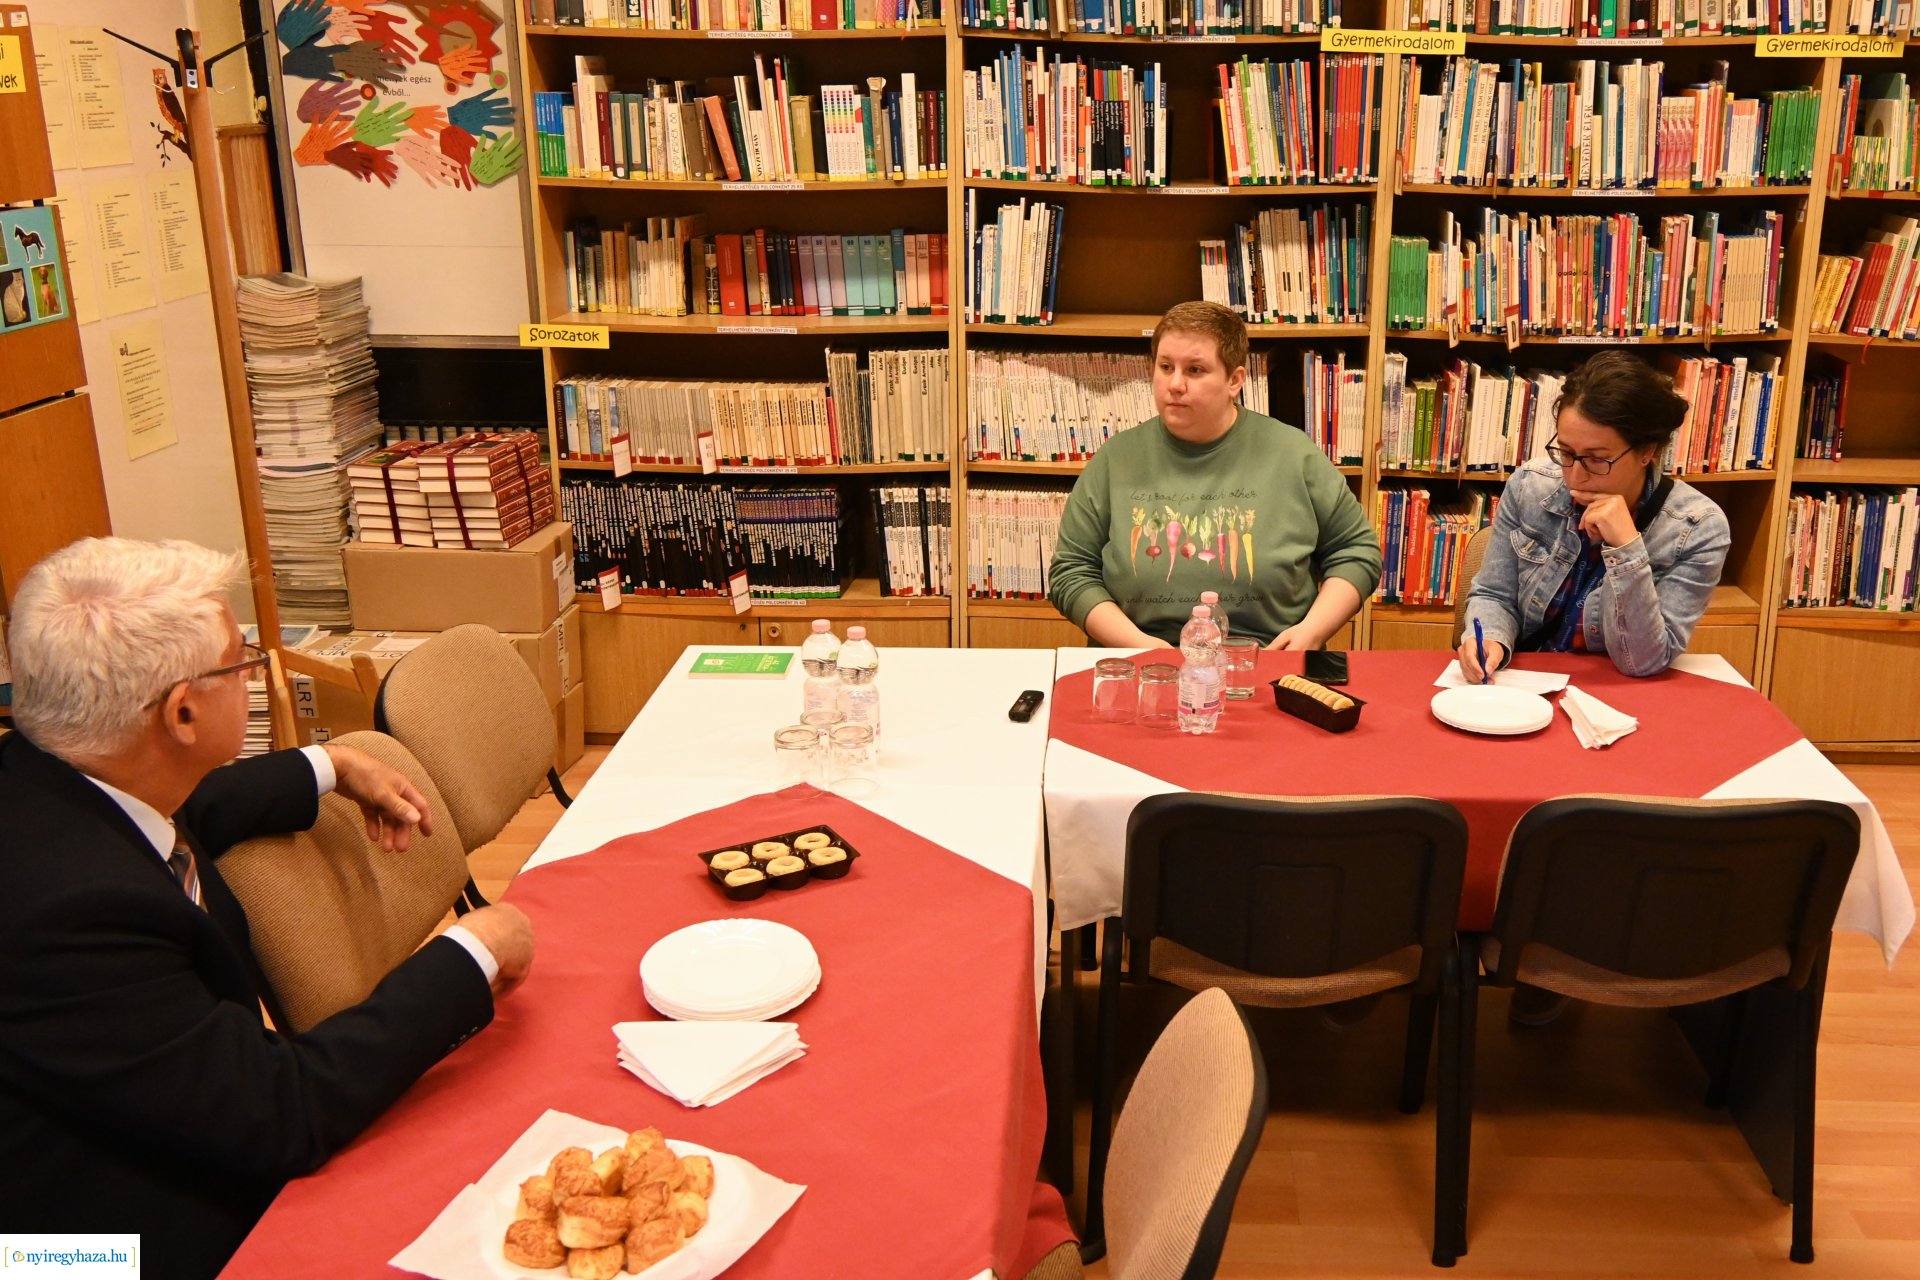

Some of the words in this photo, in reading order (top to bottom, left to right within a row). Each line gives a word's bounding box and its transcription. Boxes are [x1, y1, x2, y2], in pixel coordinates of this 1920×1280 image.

[1898, 4, 1907, 27] L
[1331, 32, 1455, 50] Gyermekirodalom
[1766, 38, 1894, 53] Gyermekirodalom
[410, 76, 431, 84] egész
[1583, 104, 1593, 132] ELEK
[529, 327, 600, 342] Sorozatok
[1510, 320, 1518, 343] D
[1729, 408, 1738, 421] nagy
[1200, 489, 1225, 502] each
[1228, 487, 1258, 501] other
